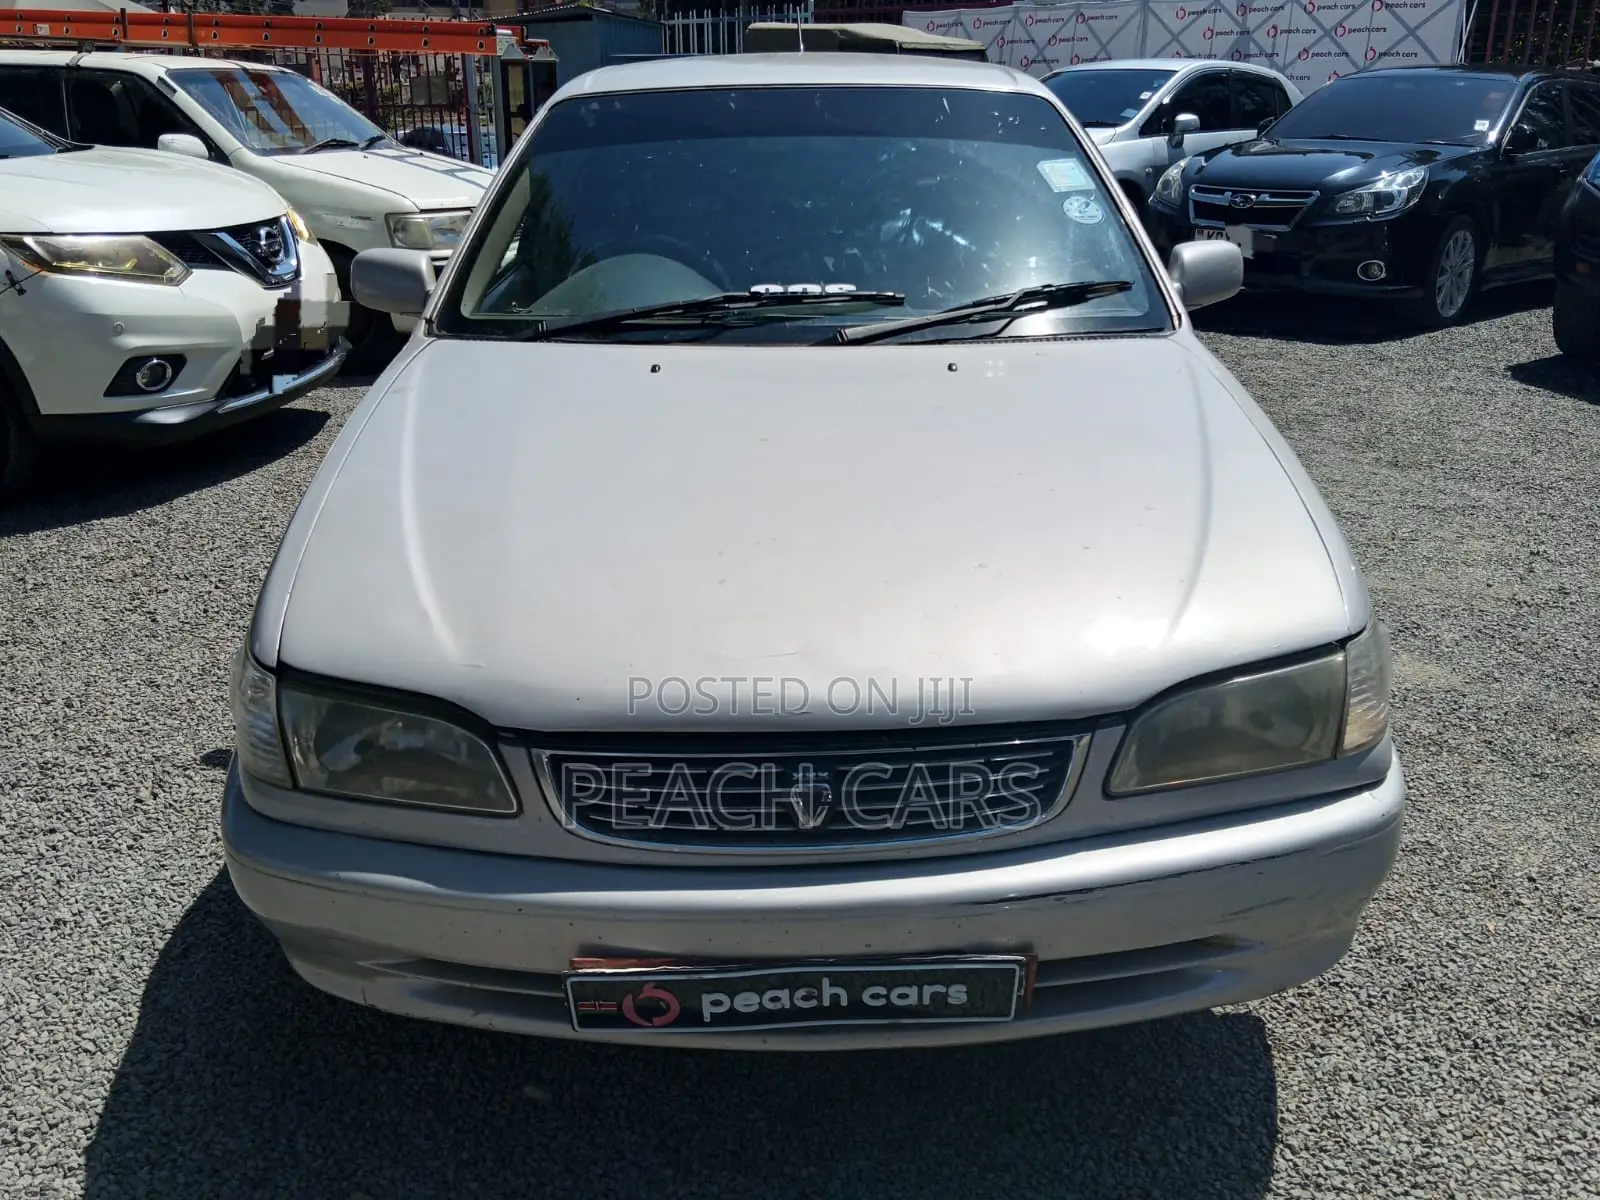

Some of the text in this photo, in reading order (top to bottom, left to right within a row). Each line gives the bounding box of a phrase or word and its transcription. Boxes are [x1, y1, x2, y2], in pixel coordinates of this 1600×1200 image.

[1249, 5, 1269, 13] peach
[1317, 3, 1339, 12] peach
[1385, 1, 1408, 10] peach
[1187, 8, 1207, 16] peach
[1035, 16, 1052, 25] peach
[1086, 14, 1103, 22] peach
[1215, 29, 1234, 37] peach
[1279, 27, 1300, 36] peach
[1348, 26, 1370, 35] peach
[1059, 35, 1075, 44] peach
[1243, 51, 1264, 59] peach
[1311, 51, 1332, 59] peach
[1378, 49, 1400, 58] peach
[701, 976, 968, 1023] peach cars
